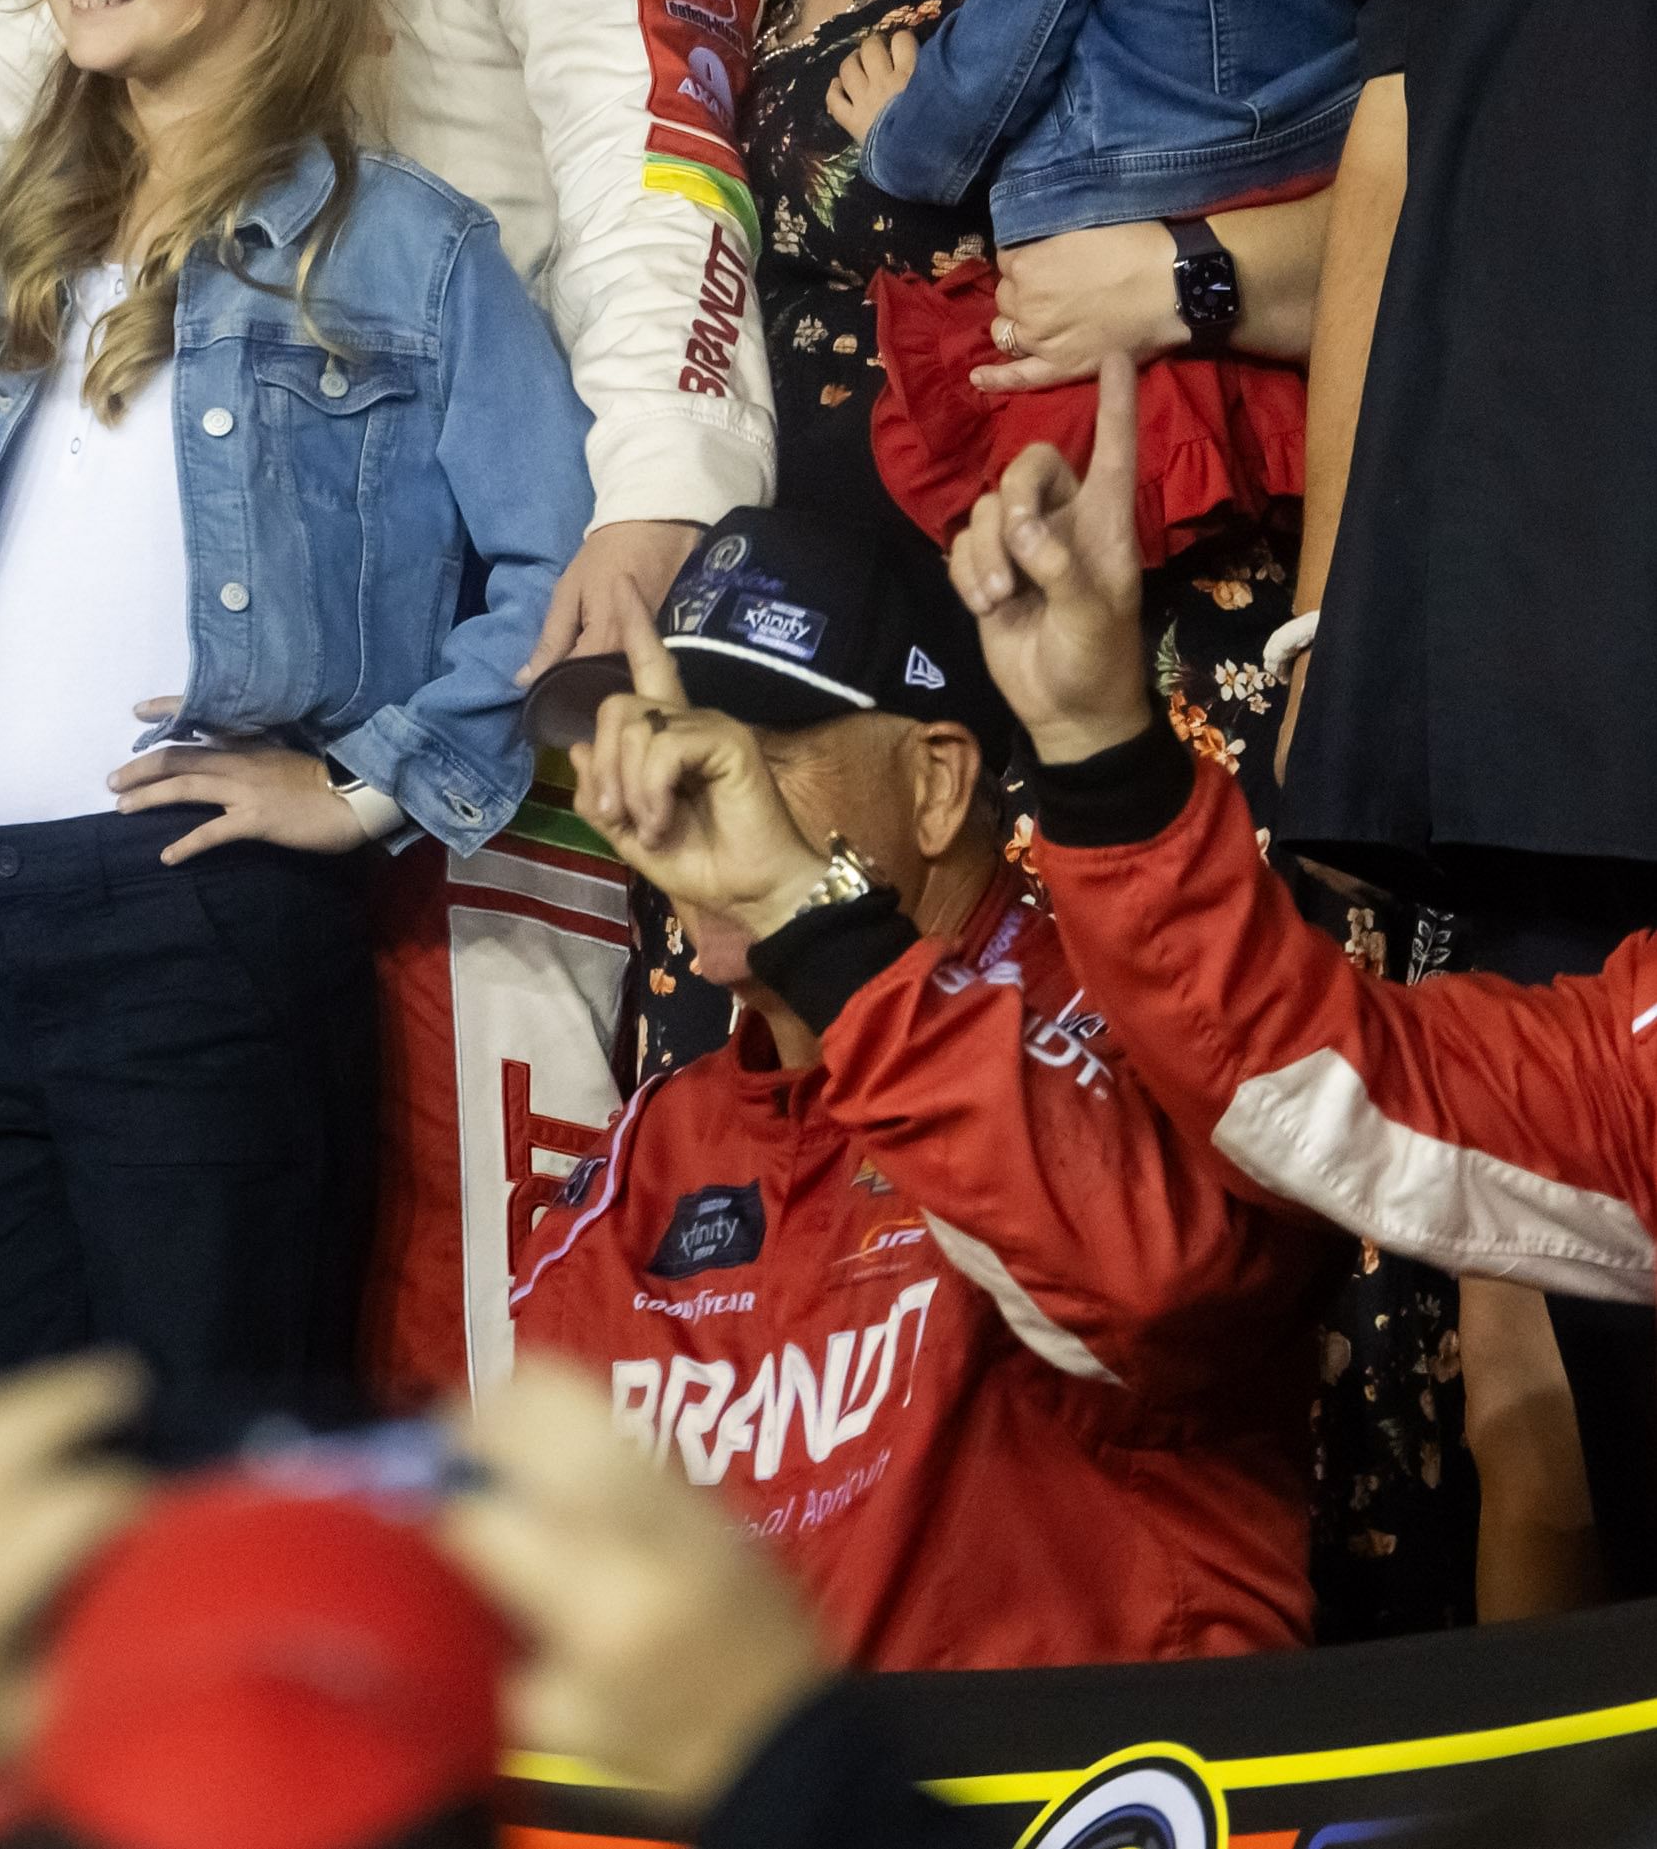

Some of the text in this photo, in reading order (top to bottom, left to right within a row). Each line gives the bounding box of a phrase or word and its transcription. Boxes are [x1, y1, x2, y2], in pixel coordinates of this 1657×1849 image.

[679, 222, 747, 398] BRANDT
[744, 607, 811, 641] xfinity
[634, 1290, 756, 1325] GOODYEAR
